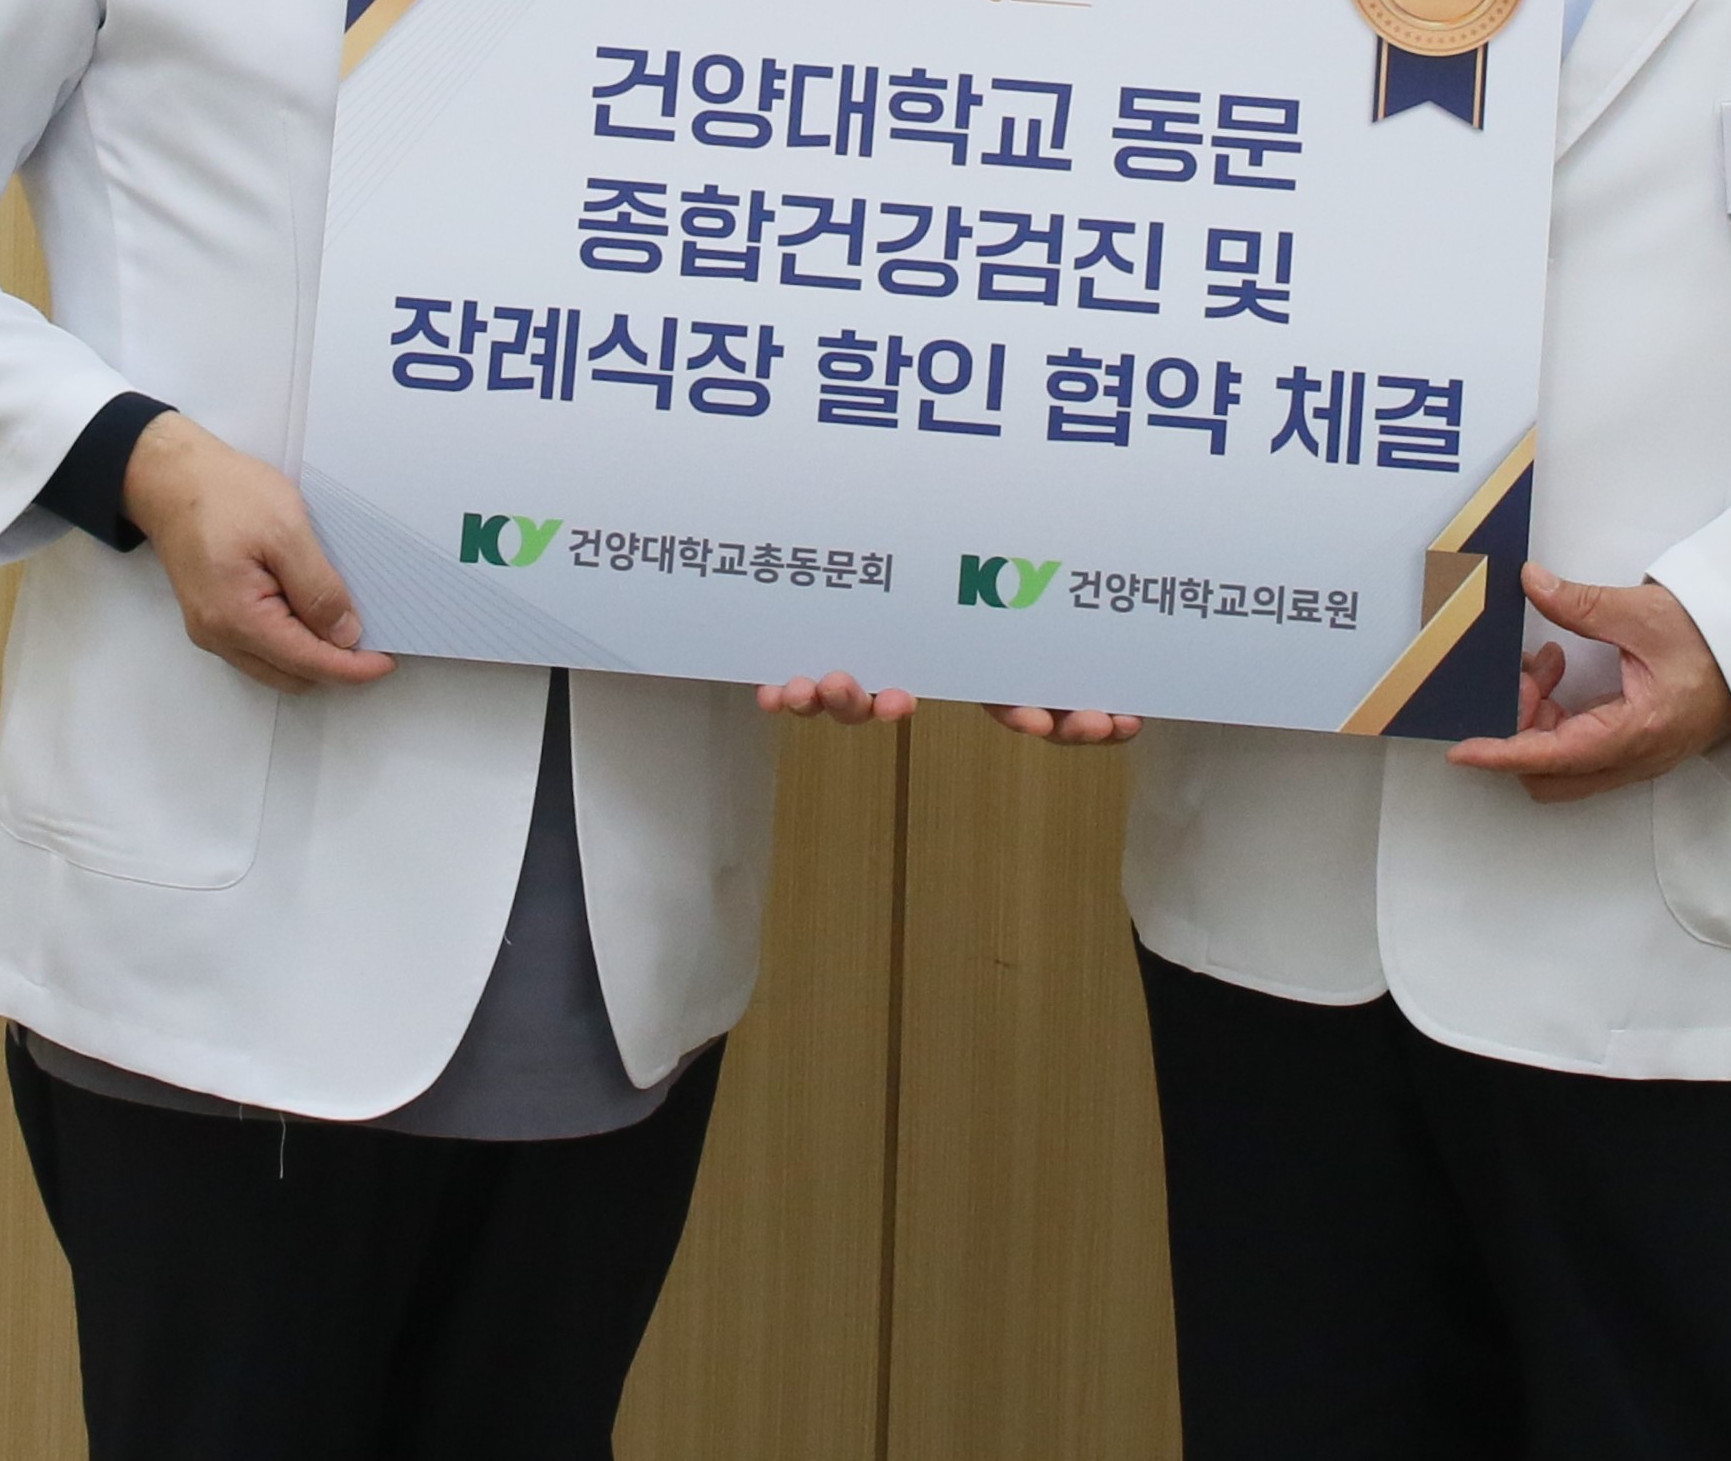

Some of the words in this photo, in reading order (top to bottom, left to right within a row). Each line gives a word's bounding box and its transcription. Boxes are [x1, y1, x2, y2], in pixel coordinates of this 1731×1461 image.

[591, 45, 1075, 174] 건양대학교
[1110, 85, 1305, 193] 동문
[576, 176, 1166, 317] 종합건강검진
[1203, 226, 1296, 326] 및
[389, 295, 786, 420] 장례식장
[816, 328, 1008, 439] 할인
[1045, 346, 1244, 458] 협약
[1270, 364, 1467, 476] 체결
[459, 511, 565, 570] KY
[568, 527, 895, 595] 건양대학교총동문회
[957, 553, 1064, 611] KY
[1068, 569, 1361, 633] 건양대학교의료원
